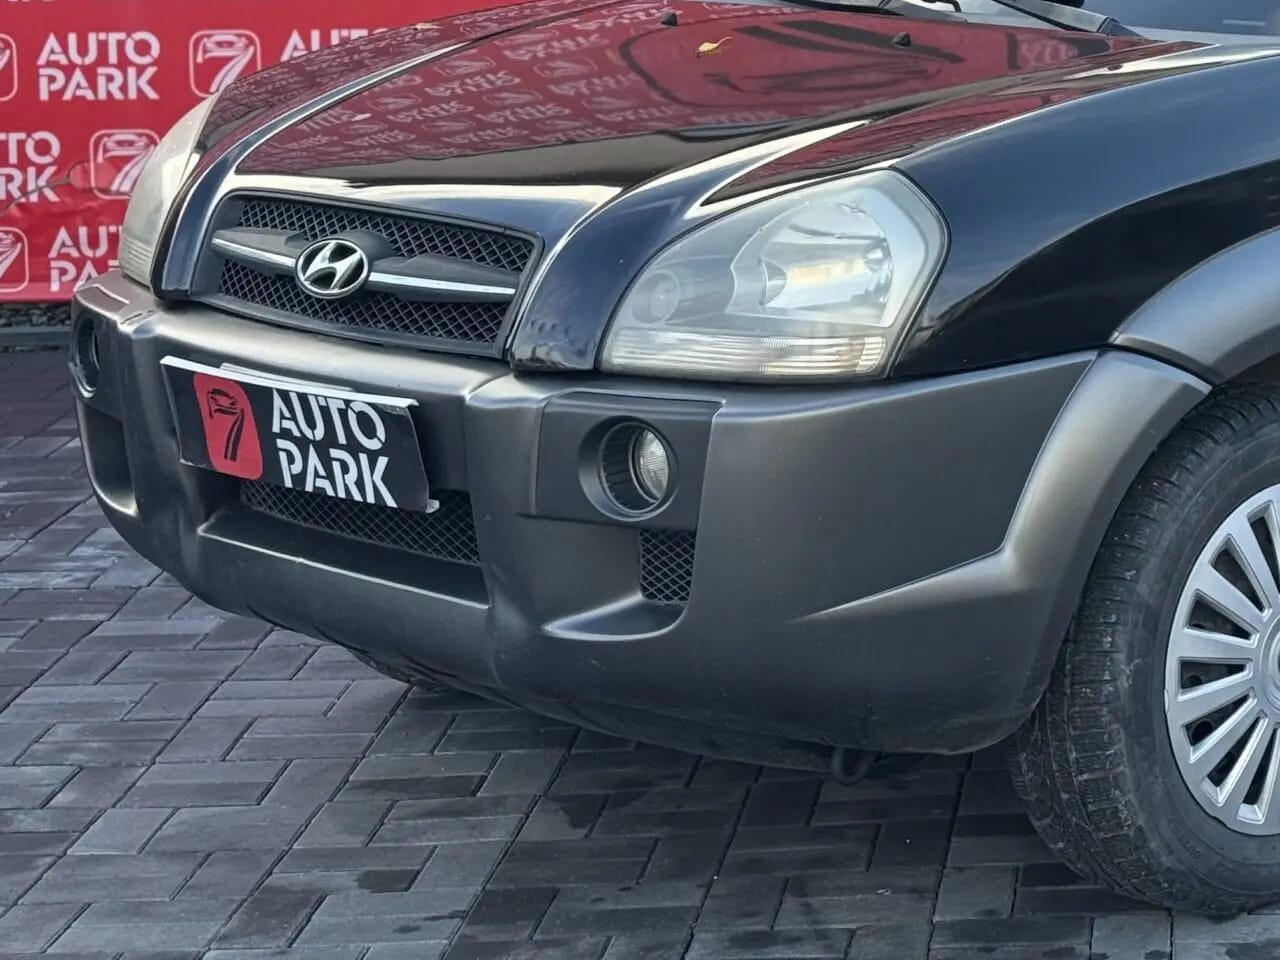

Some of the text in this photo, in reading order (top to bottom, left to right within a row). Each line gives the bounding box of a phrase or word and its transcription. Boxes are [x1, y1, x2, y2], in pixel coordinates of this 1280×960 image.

[38, 32, 160, 64] AUTO
[39, 67, 158, 100] PARK
[272, 388, 386, 450] AUTO
[276, 438, 398, 508] PARK
